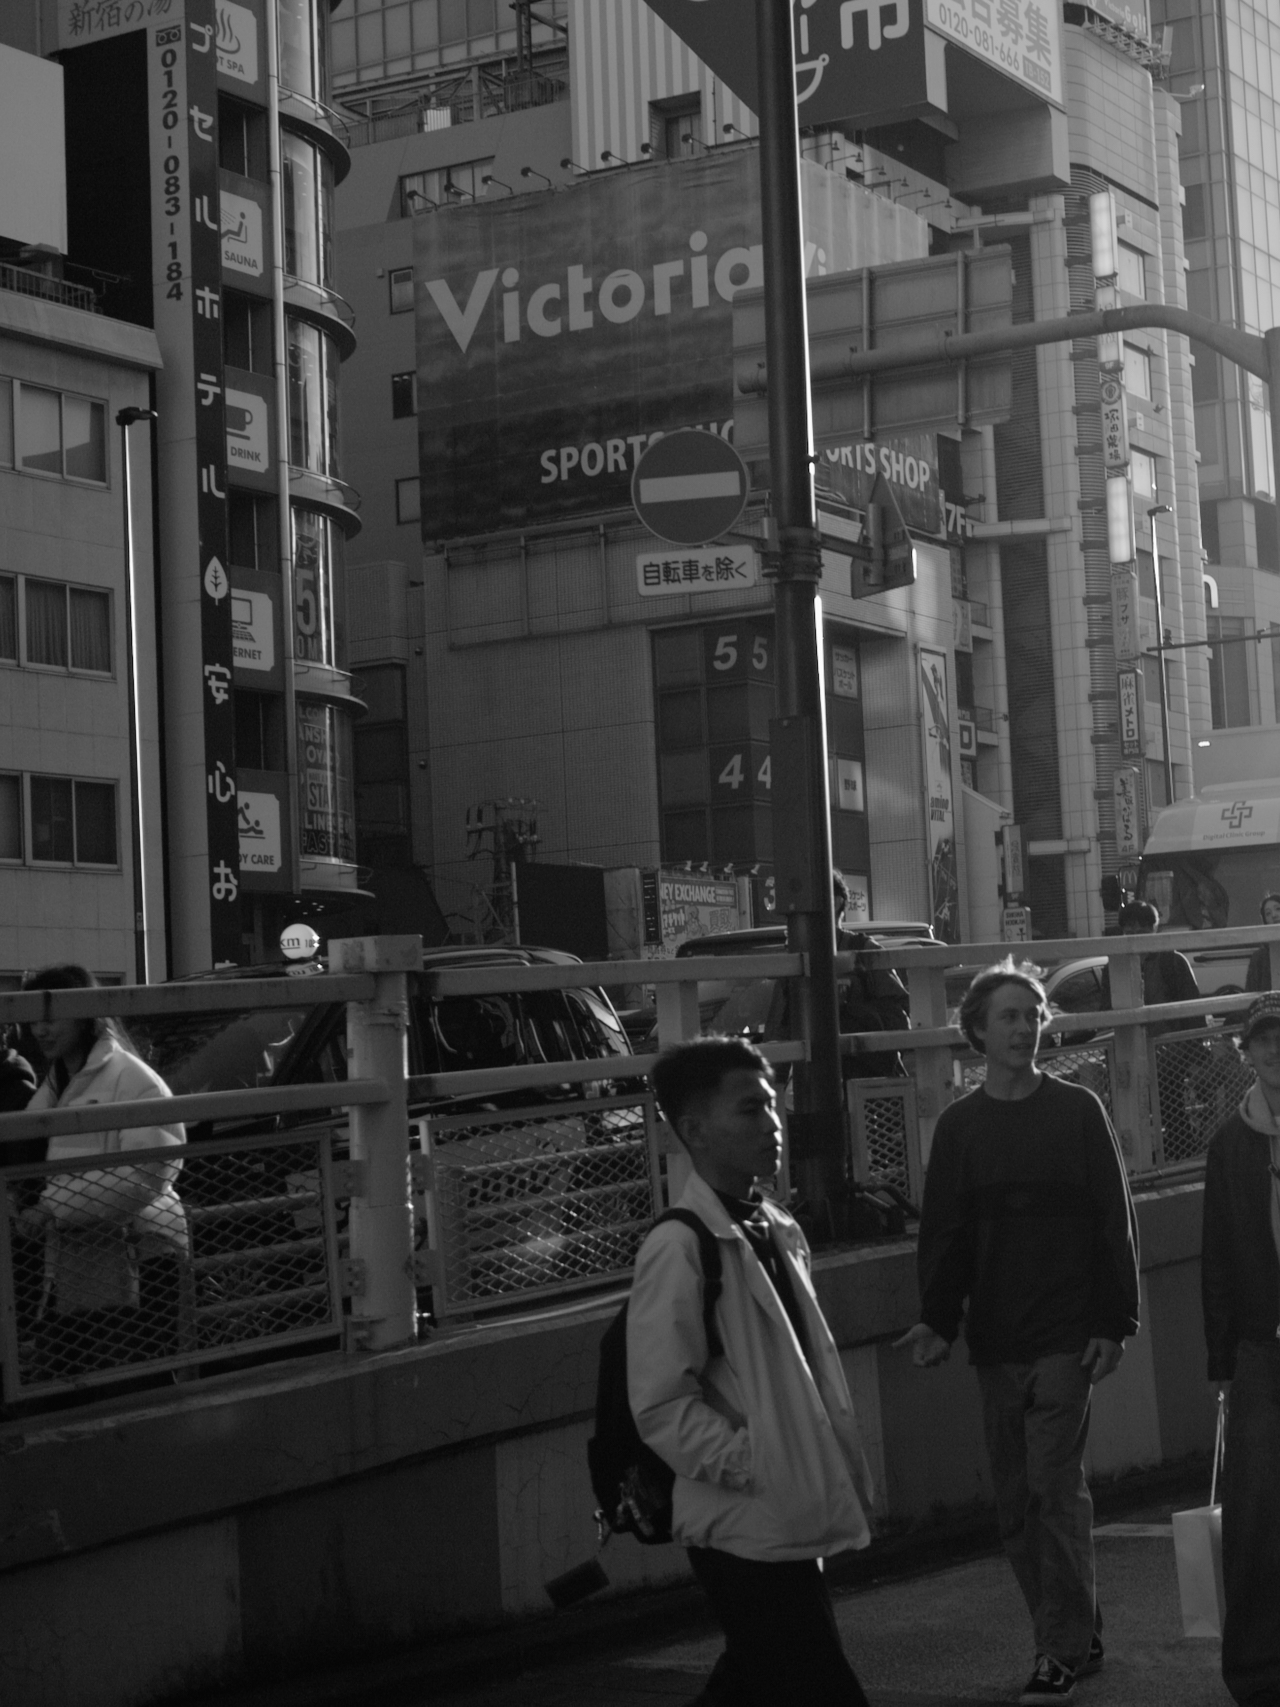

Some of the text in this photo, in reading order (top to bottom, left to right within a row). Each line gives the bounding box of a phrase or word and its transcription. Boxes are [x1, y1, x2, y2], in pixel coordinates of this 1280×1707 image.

[939, 3, 1020, 71] 0120-081-666
[227, 59, 245, 75] SPA
[160, 48, 184, 301] 0120-083-184
[223, 249, 260, 271] SAUNA
[230, 446, 261, 463] DRINK
[540, 431, 665, 484] SPORT
[880, 447, 931, 492] SHOP
[642, 556, 748, 587] 自転車を除く
[233, 647, 262, 661] ERNET
[713, 635, 738, 671] 5
[752, 635, 769, 671] 5
[718, 754, 745, 790] 4
[1203, 834, 1225, 842] Digital
[1245, 831, 1266, 839] Group
[251, 854, 275, 866] CARE
[674, 884, 716, 904] EXCHANGE
